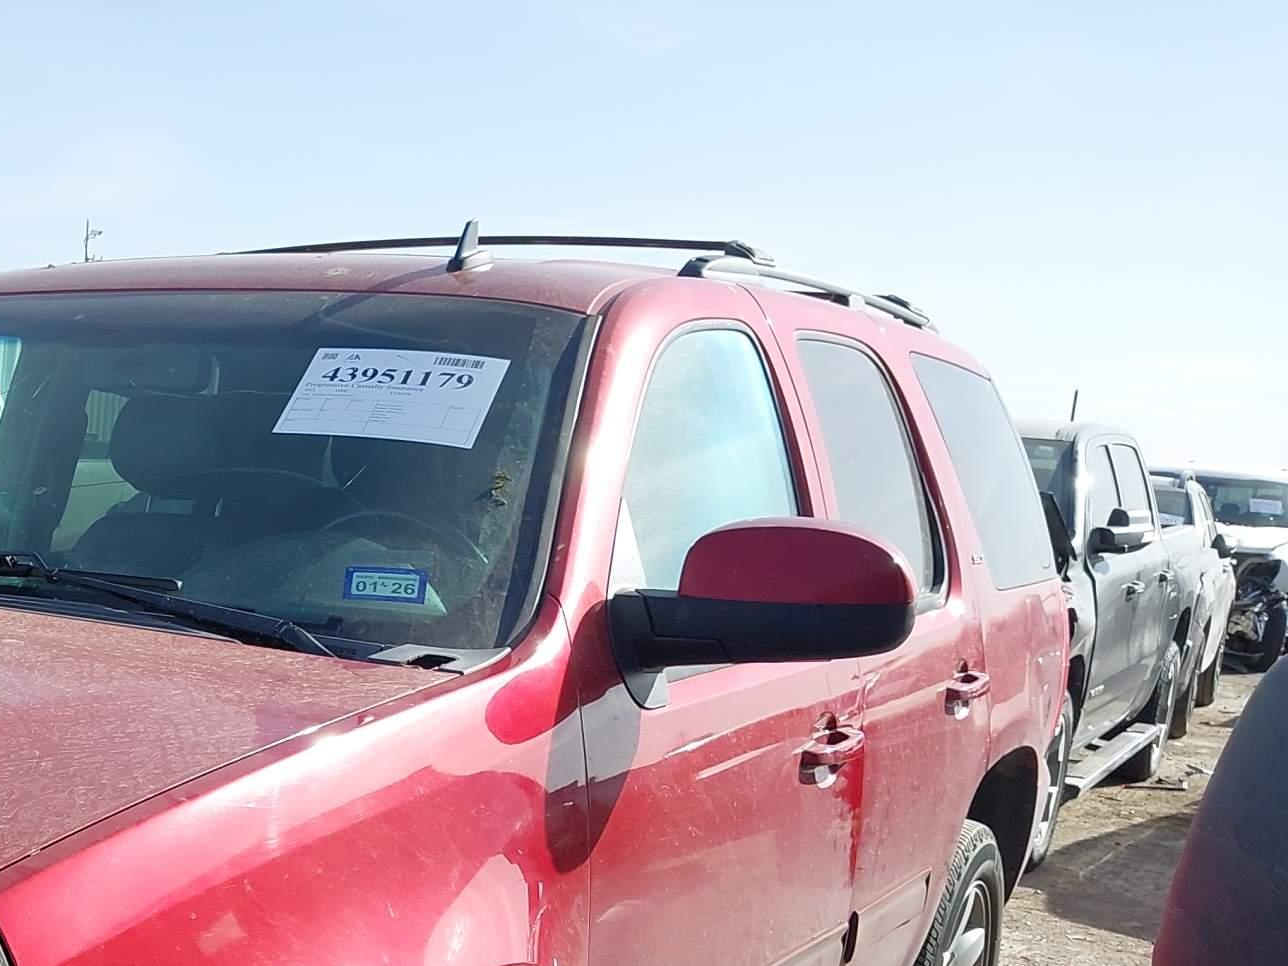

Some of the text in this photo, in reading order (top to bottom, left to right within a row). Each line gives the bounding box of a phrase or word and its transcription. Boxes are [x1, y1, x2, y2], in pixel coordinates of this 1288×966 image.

[322, 366, 474, 390] 43951179
[351, 382, 384, 390] Casualty
[386, 384, 425, 392] Insurance
[355, 580, 416, 595] 01 26
